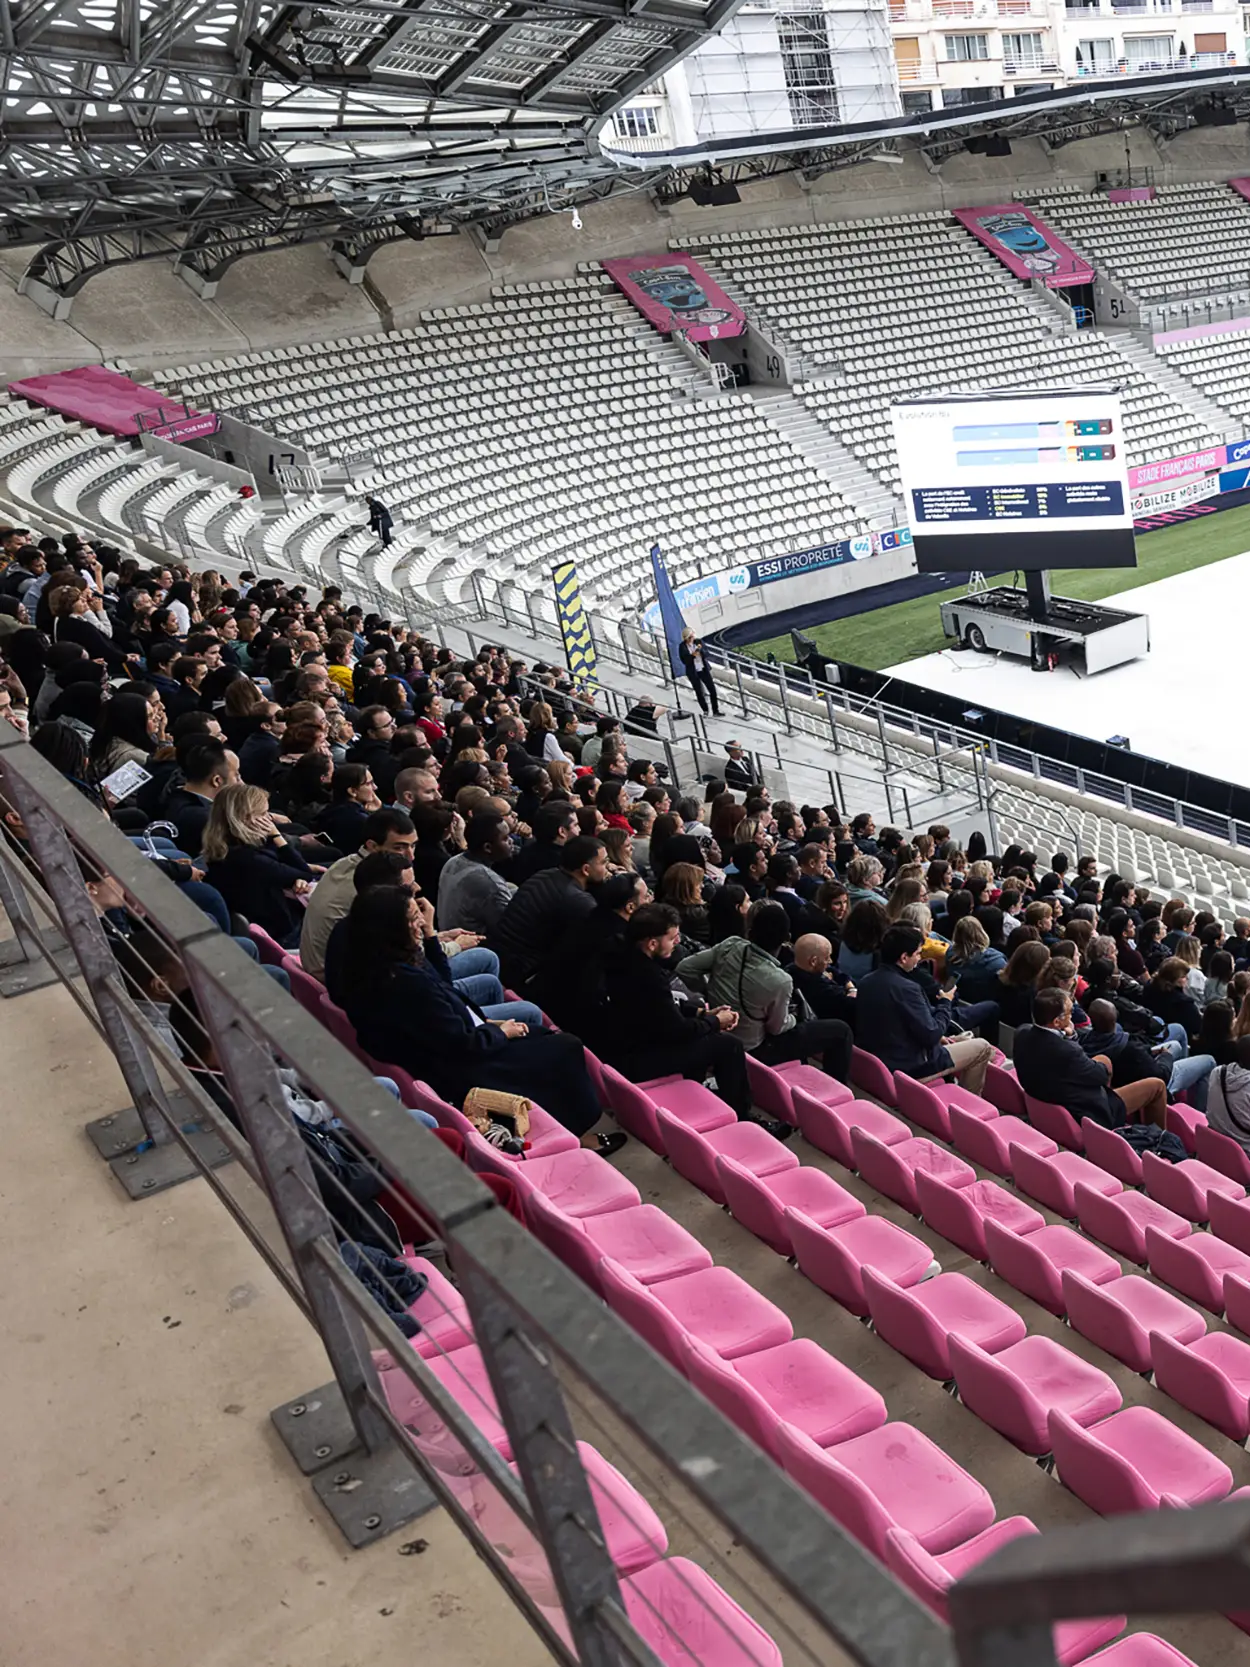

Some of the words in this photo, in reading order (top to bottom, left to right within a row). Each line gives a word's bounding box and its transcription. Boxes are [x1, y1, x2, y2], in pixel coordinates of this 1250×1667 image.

[1111, 299, 1126, 319] 51
[766, 355, 780, 379] 49
[1137, 465, 1160, 484] STADE
[1180, 477, 1215, 497] MOBILIZE
[756, 559, 782, 577] ESSI
[784, 544, 844, 571] PROPRETÉ
